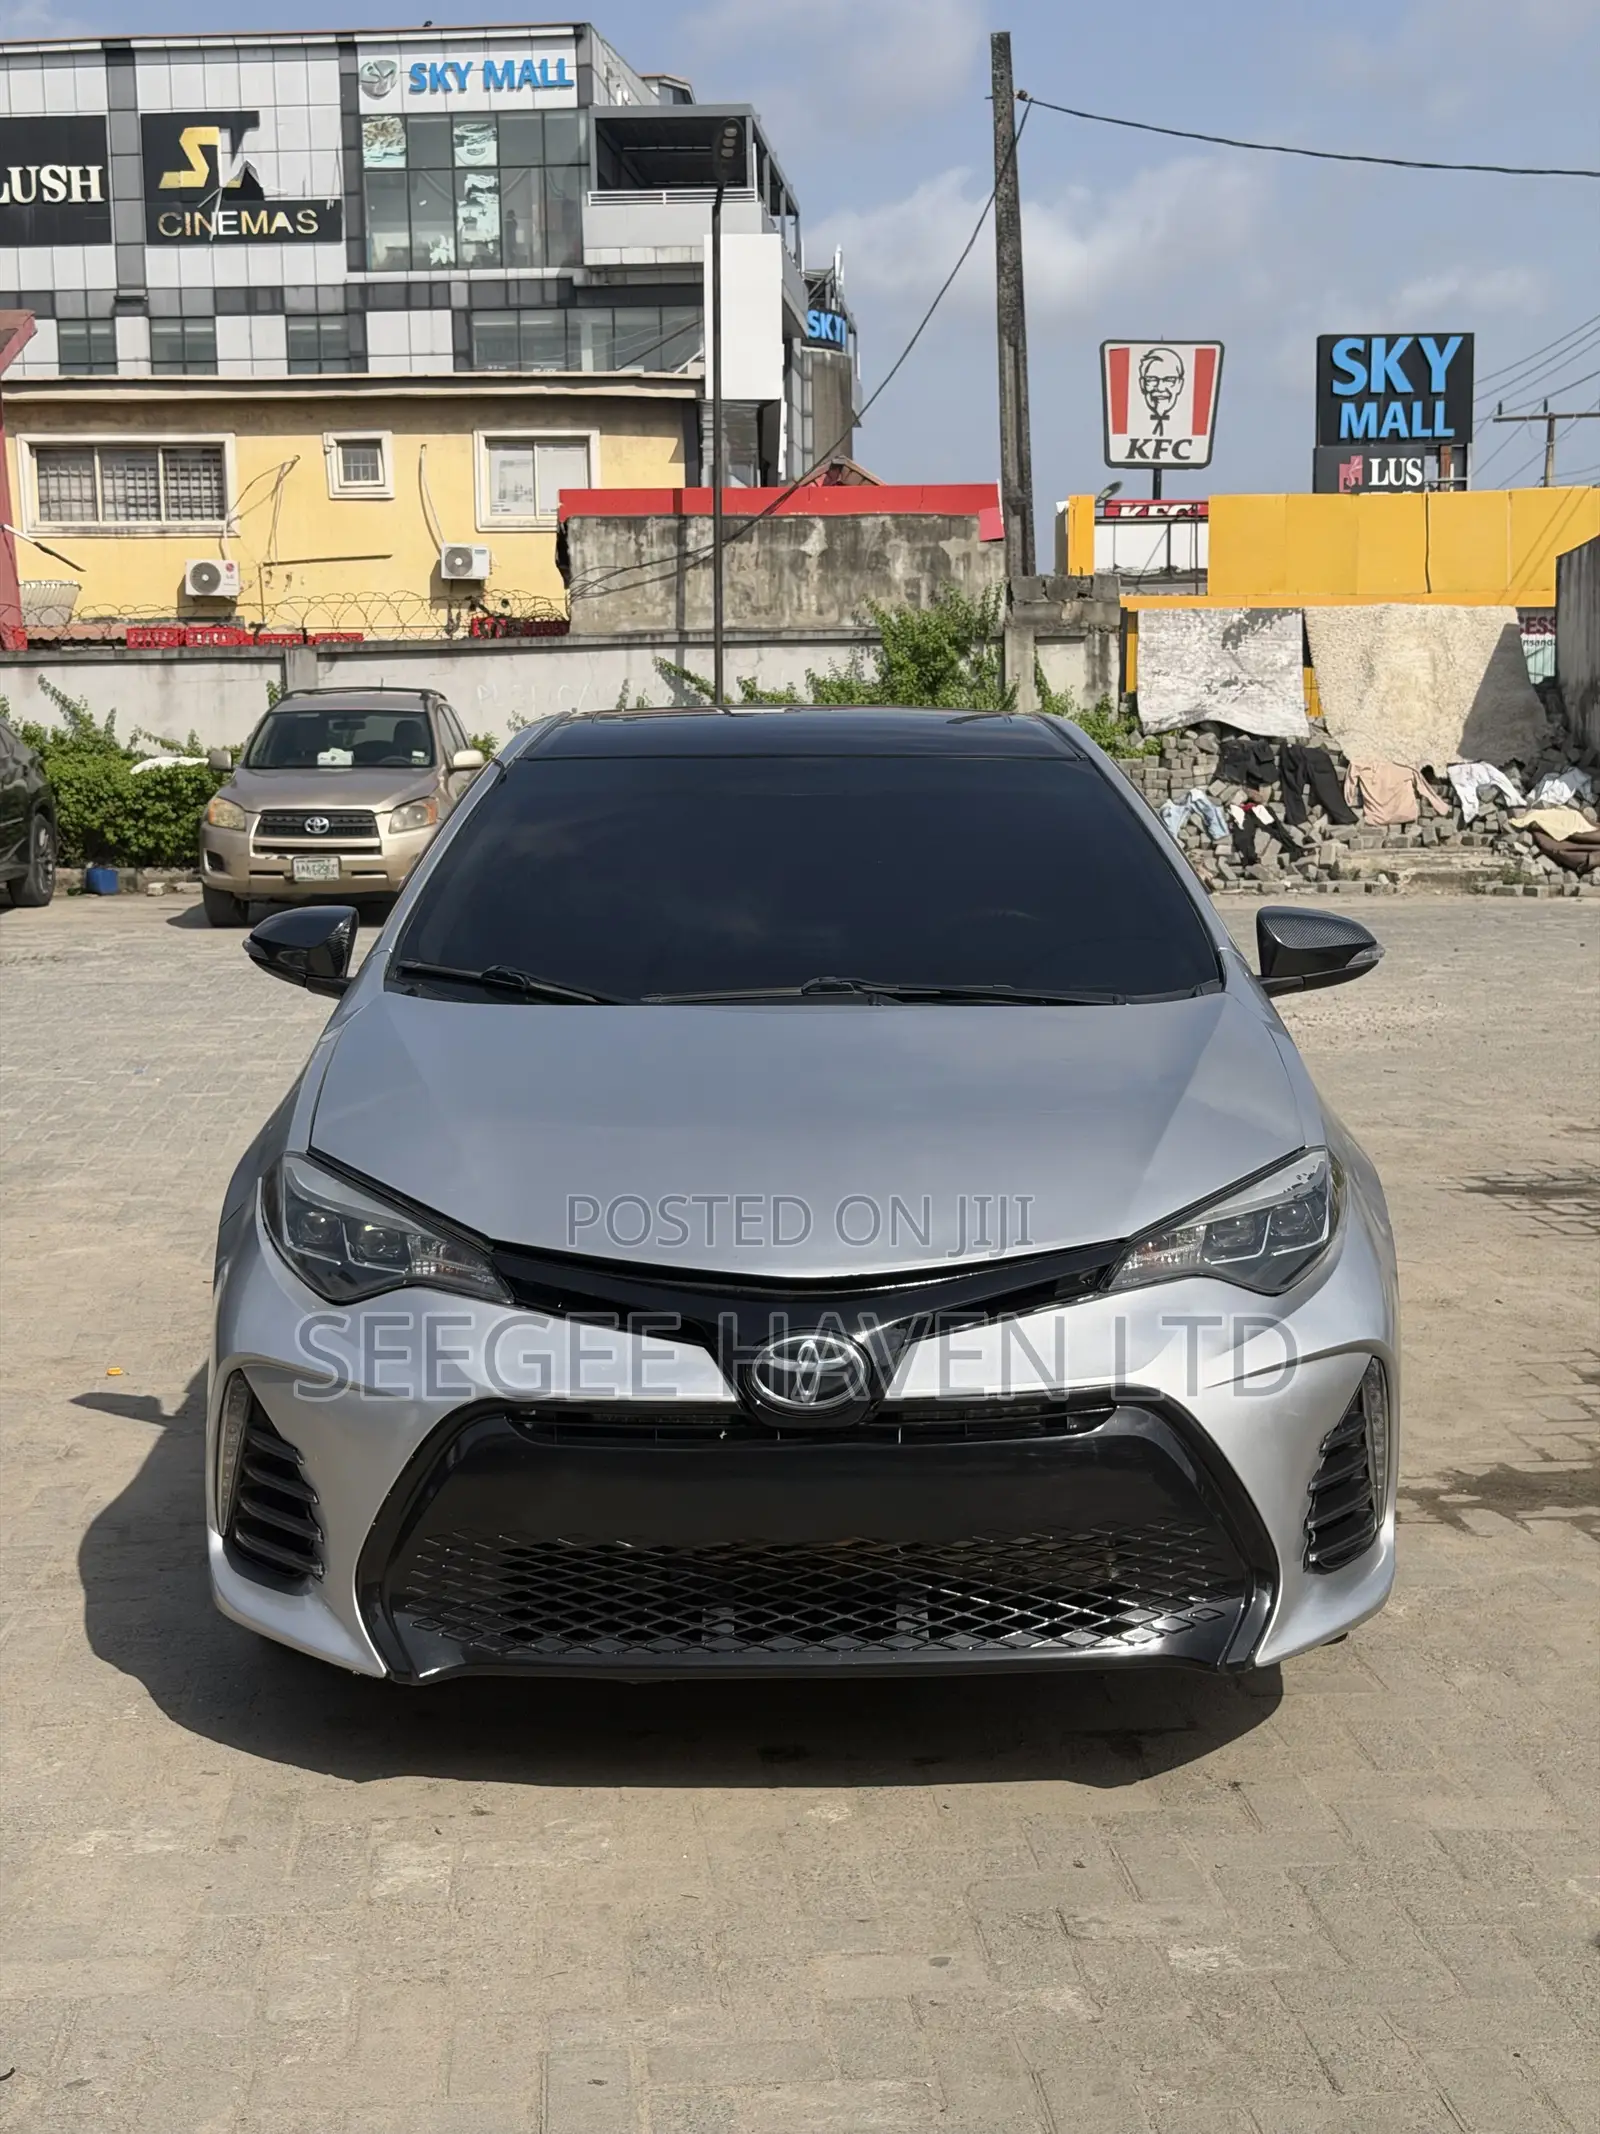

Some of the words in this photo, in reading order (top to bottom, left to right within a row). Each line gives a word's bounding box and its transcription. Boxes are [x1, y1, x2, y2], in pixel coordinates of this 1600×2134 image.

[409, 61, 473, 94] SKY
[483, 58, 574, 92] MALL
[0, 164, 105, 204] USH
[158, 208, 319, 238] CINEMAS
[1332, 336, 1463, 396] SKY
[1339, 401, 1455, 439] MALL
[1124, 438, 1193, 460] KFC
